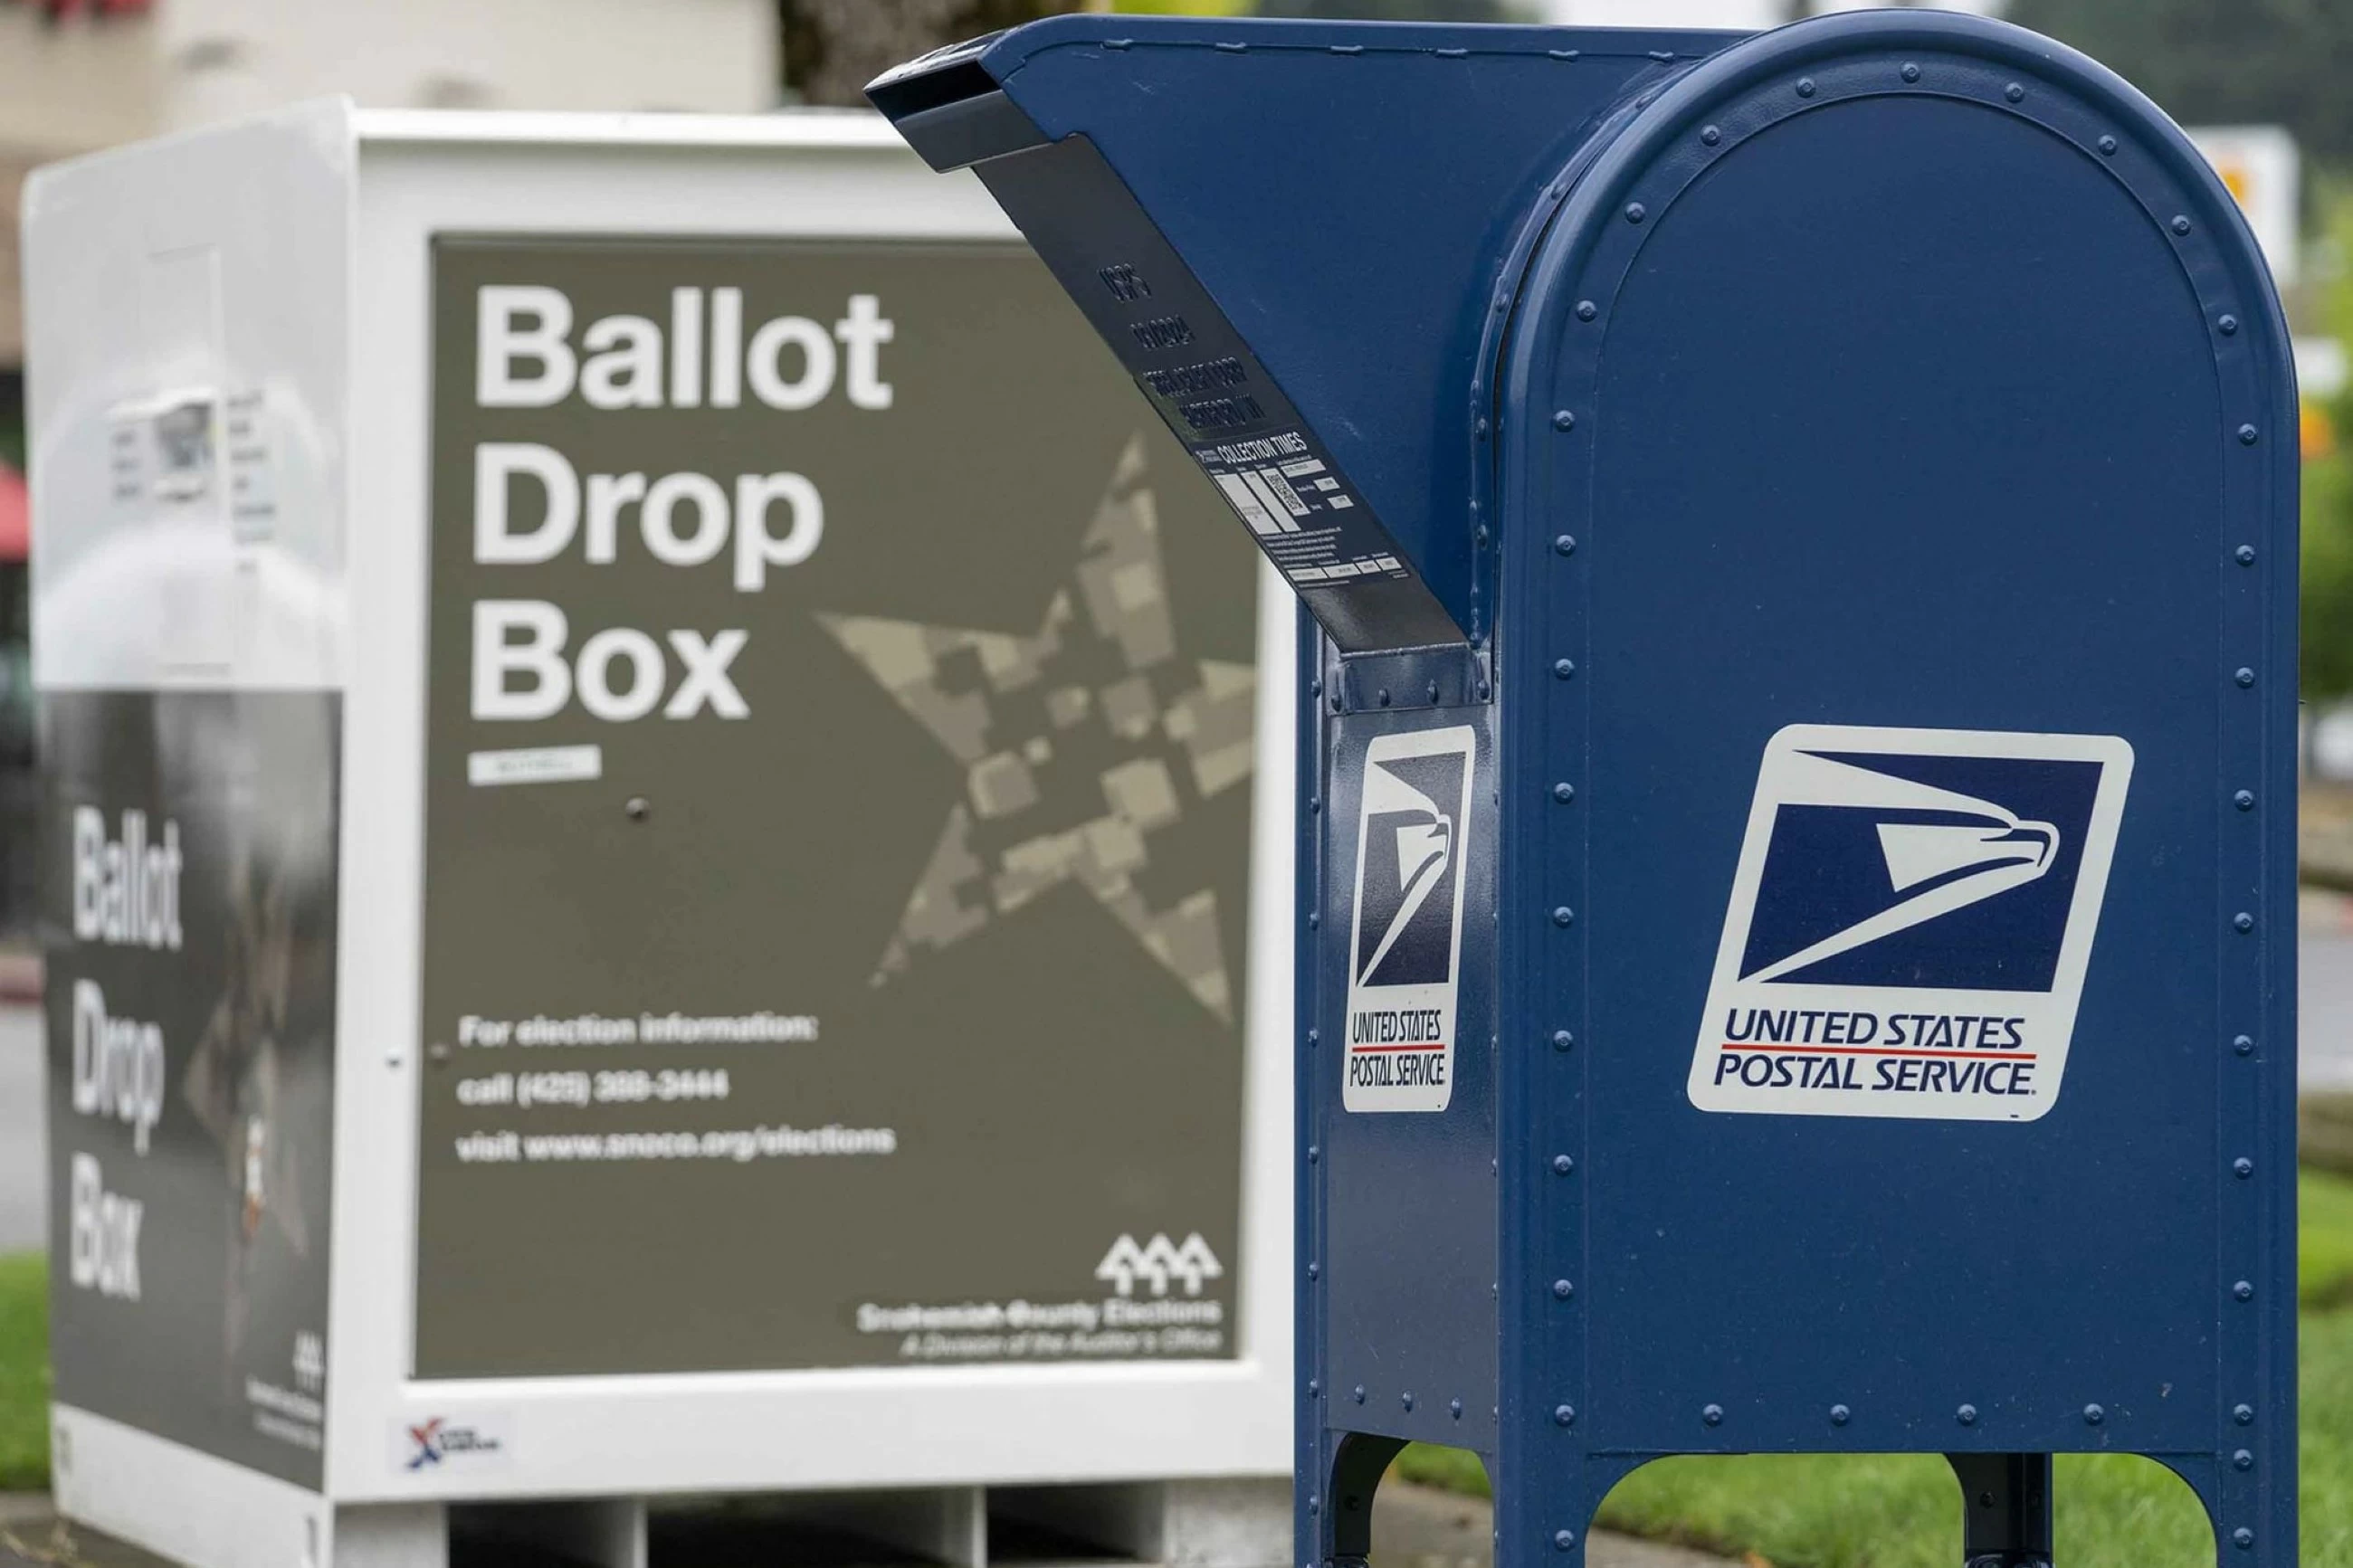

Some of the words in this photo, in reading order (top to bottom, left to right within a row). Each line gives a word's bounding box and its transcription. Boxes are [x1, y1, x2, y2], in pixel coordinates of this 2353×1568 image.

[476, 285, 896, 411] Ballot
[1216, 437, 1279, 464] COLLECTION
[1269, 431, 1308, 455] TIMES
[473, 442, 824, 592] Drop
[471, 599, 751, 722] Box
[71, 804, 183, 951] Ballot
[458, 1013, 515, 1049] For
[514, 1012, 637, 1048] election
[639, 1011, 819, 1044] information:
[1353, 1011, 1398, 1044] UNITED
[1398, 1009, 1442, 1041] STATES
[1724, 1008, 1879, 1045] UNITED
[1882, 1013, 2026, 1050] STATES
[71, 977, 166, 1156] Drop
[1349, 1054, 1394, 1087] POSTAL
[1396, 1053, 1445, 1086] SERVICE
[1714, 1052, 1863, 1091] POSTAL
[1872, 1058, 2036, 1096] SERVICE
[456, 1070, 515, 1106] call
[516, 1069, 592, 1109] (425)
[454, 1130, 520, 1163] visit
[71, 1152, 144, 1303] Box
[1102, 1297, 1224, 1326] Elections
